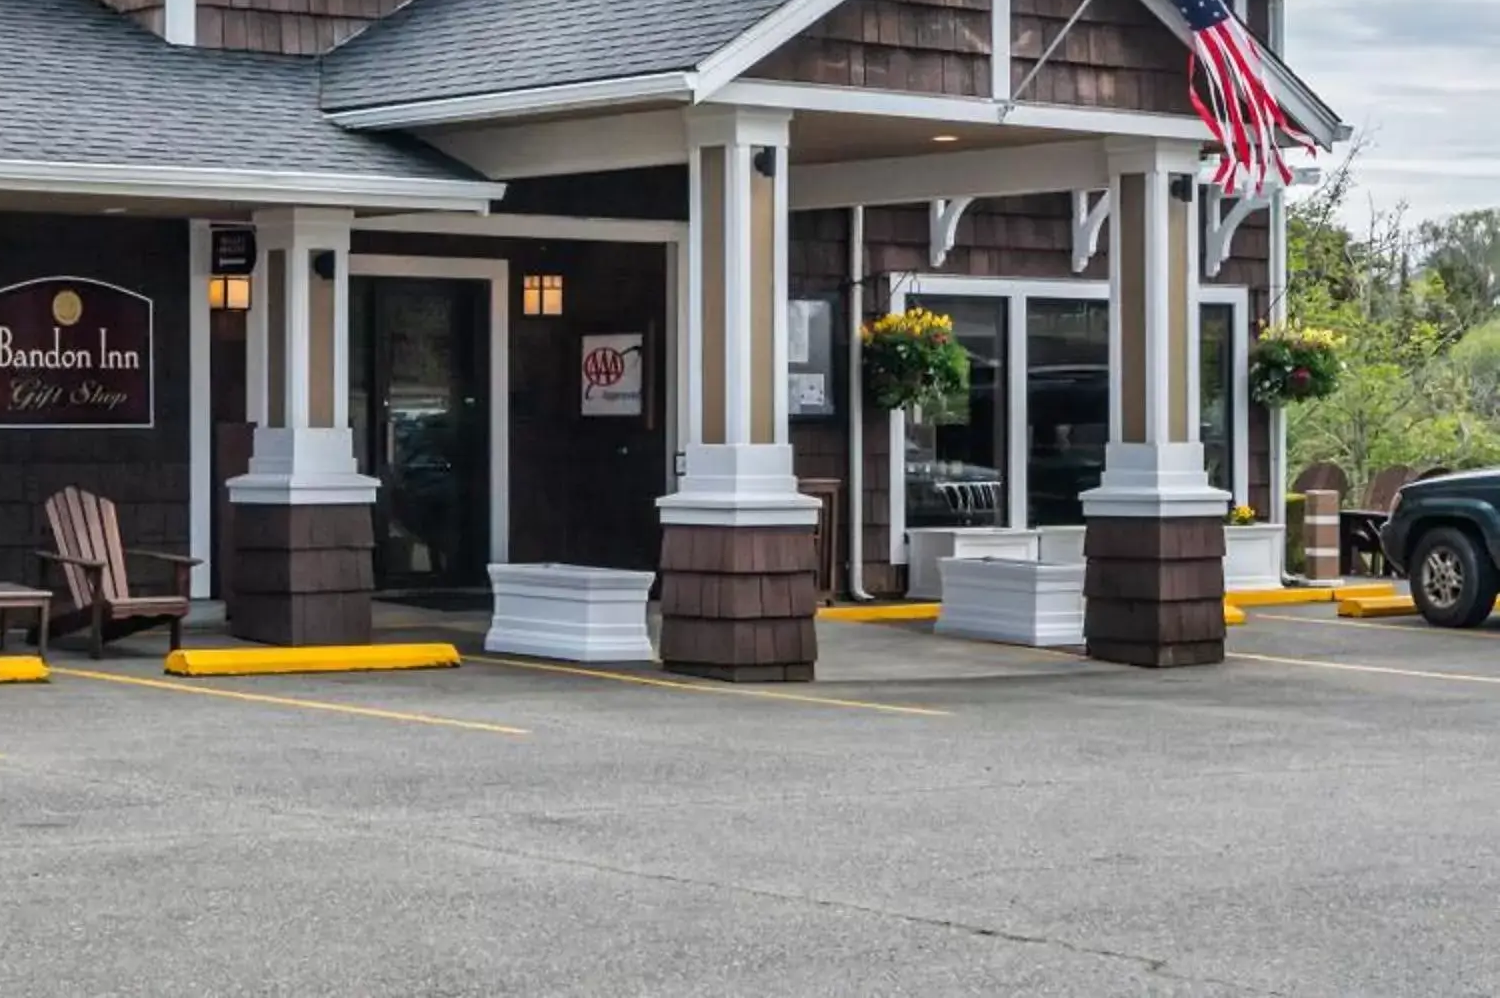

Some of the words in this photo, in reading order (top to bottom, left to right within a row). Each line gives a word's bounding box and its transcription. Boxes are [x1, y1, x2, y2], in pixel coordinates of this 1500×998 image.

[100, 328, 139, 369] Inn
[585, 348, 623, 385] AAA
[8, 376, 63, 410] Gift
[70, 381, 127, 410] Shop
